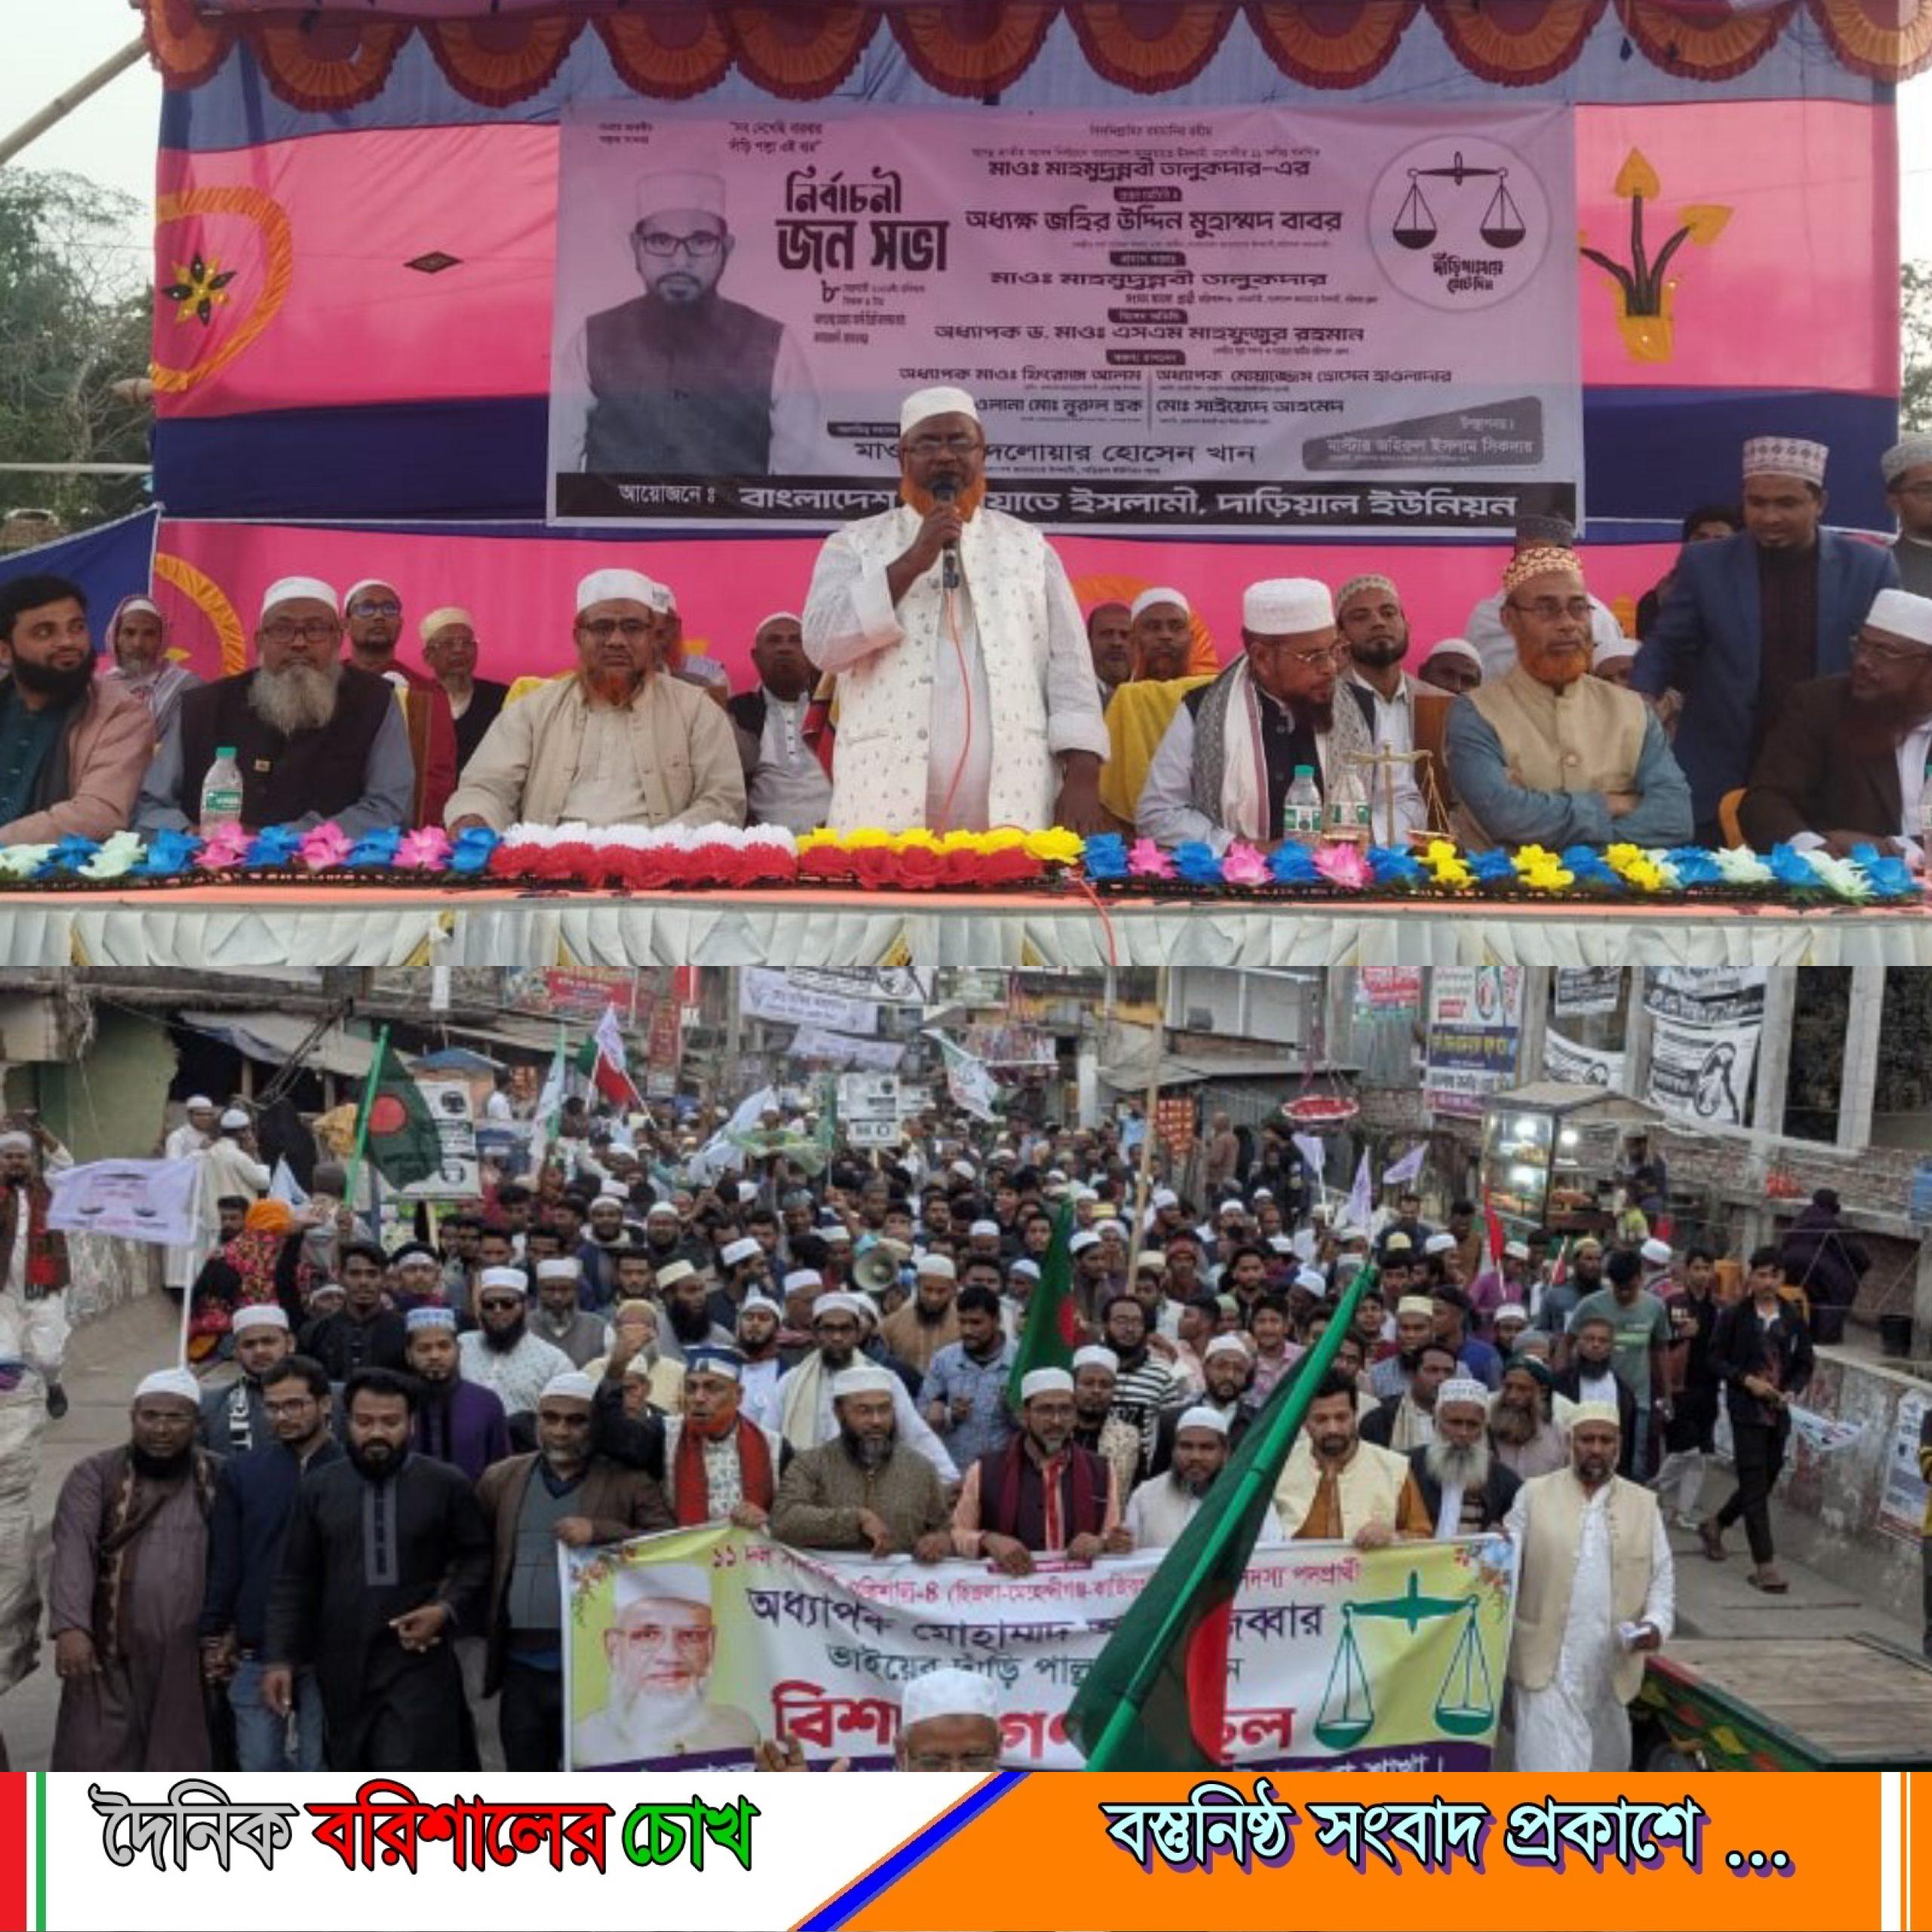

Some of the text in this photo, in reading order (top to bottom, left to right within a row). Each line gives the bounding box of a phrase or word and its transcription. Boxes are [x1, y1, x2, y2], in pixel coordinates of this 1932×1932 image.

[786, 165, 901, 214] নির্বাচনী
[964, 205, 1343, 238] অধ্যক্ষ জহির উদ্দিন মুহাম্মদ বাবর
[775, 220, 950, 275] জন সভা
[934, 326, 1020, 339] অধ্যাপক
[1112, 326, 1183, 339] এসএম
[1293, 328, 1364, 341] রহমান
[974, 398, 1024, 412] ওলানা
[1102, 444, 1194, 464] হোসেন
[1207, 444, 1256, 465] খান
[618, 484, 701, 504] আয়োজনে
[739, 488, 897, 509] বাংলাদেশ
[1216, 486, 1359, 518] দাড়িয়াল
[1367, 488, 1518, 518] ইউনিয়ন
[746, 1587, 895, 1636] অধ্যাপক
[771, 1679, 903, 1749] বিশা
